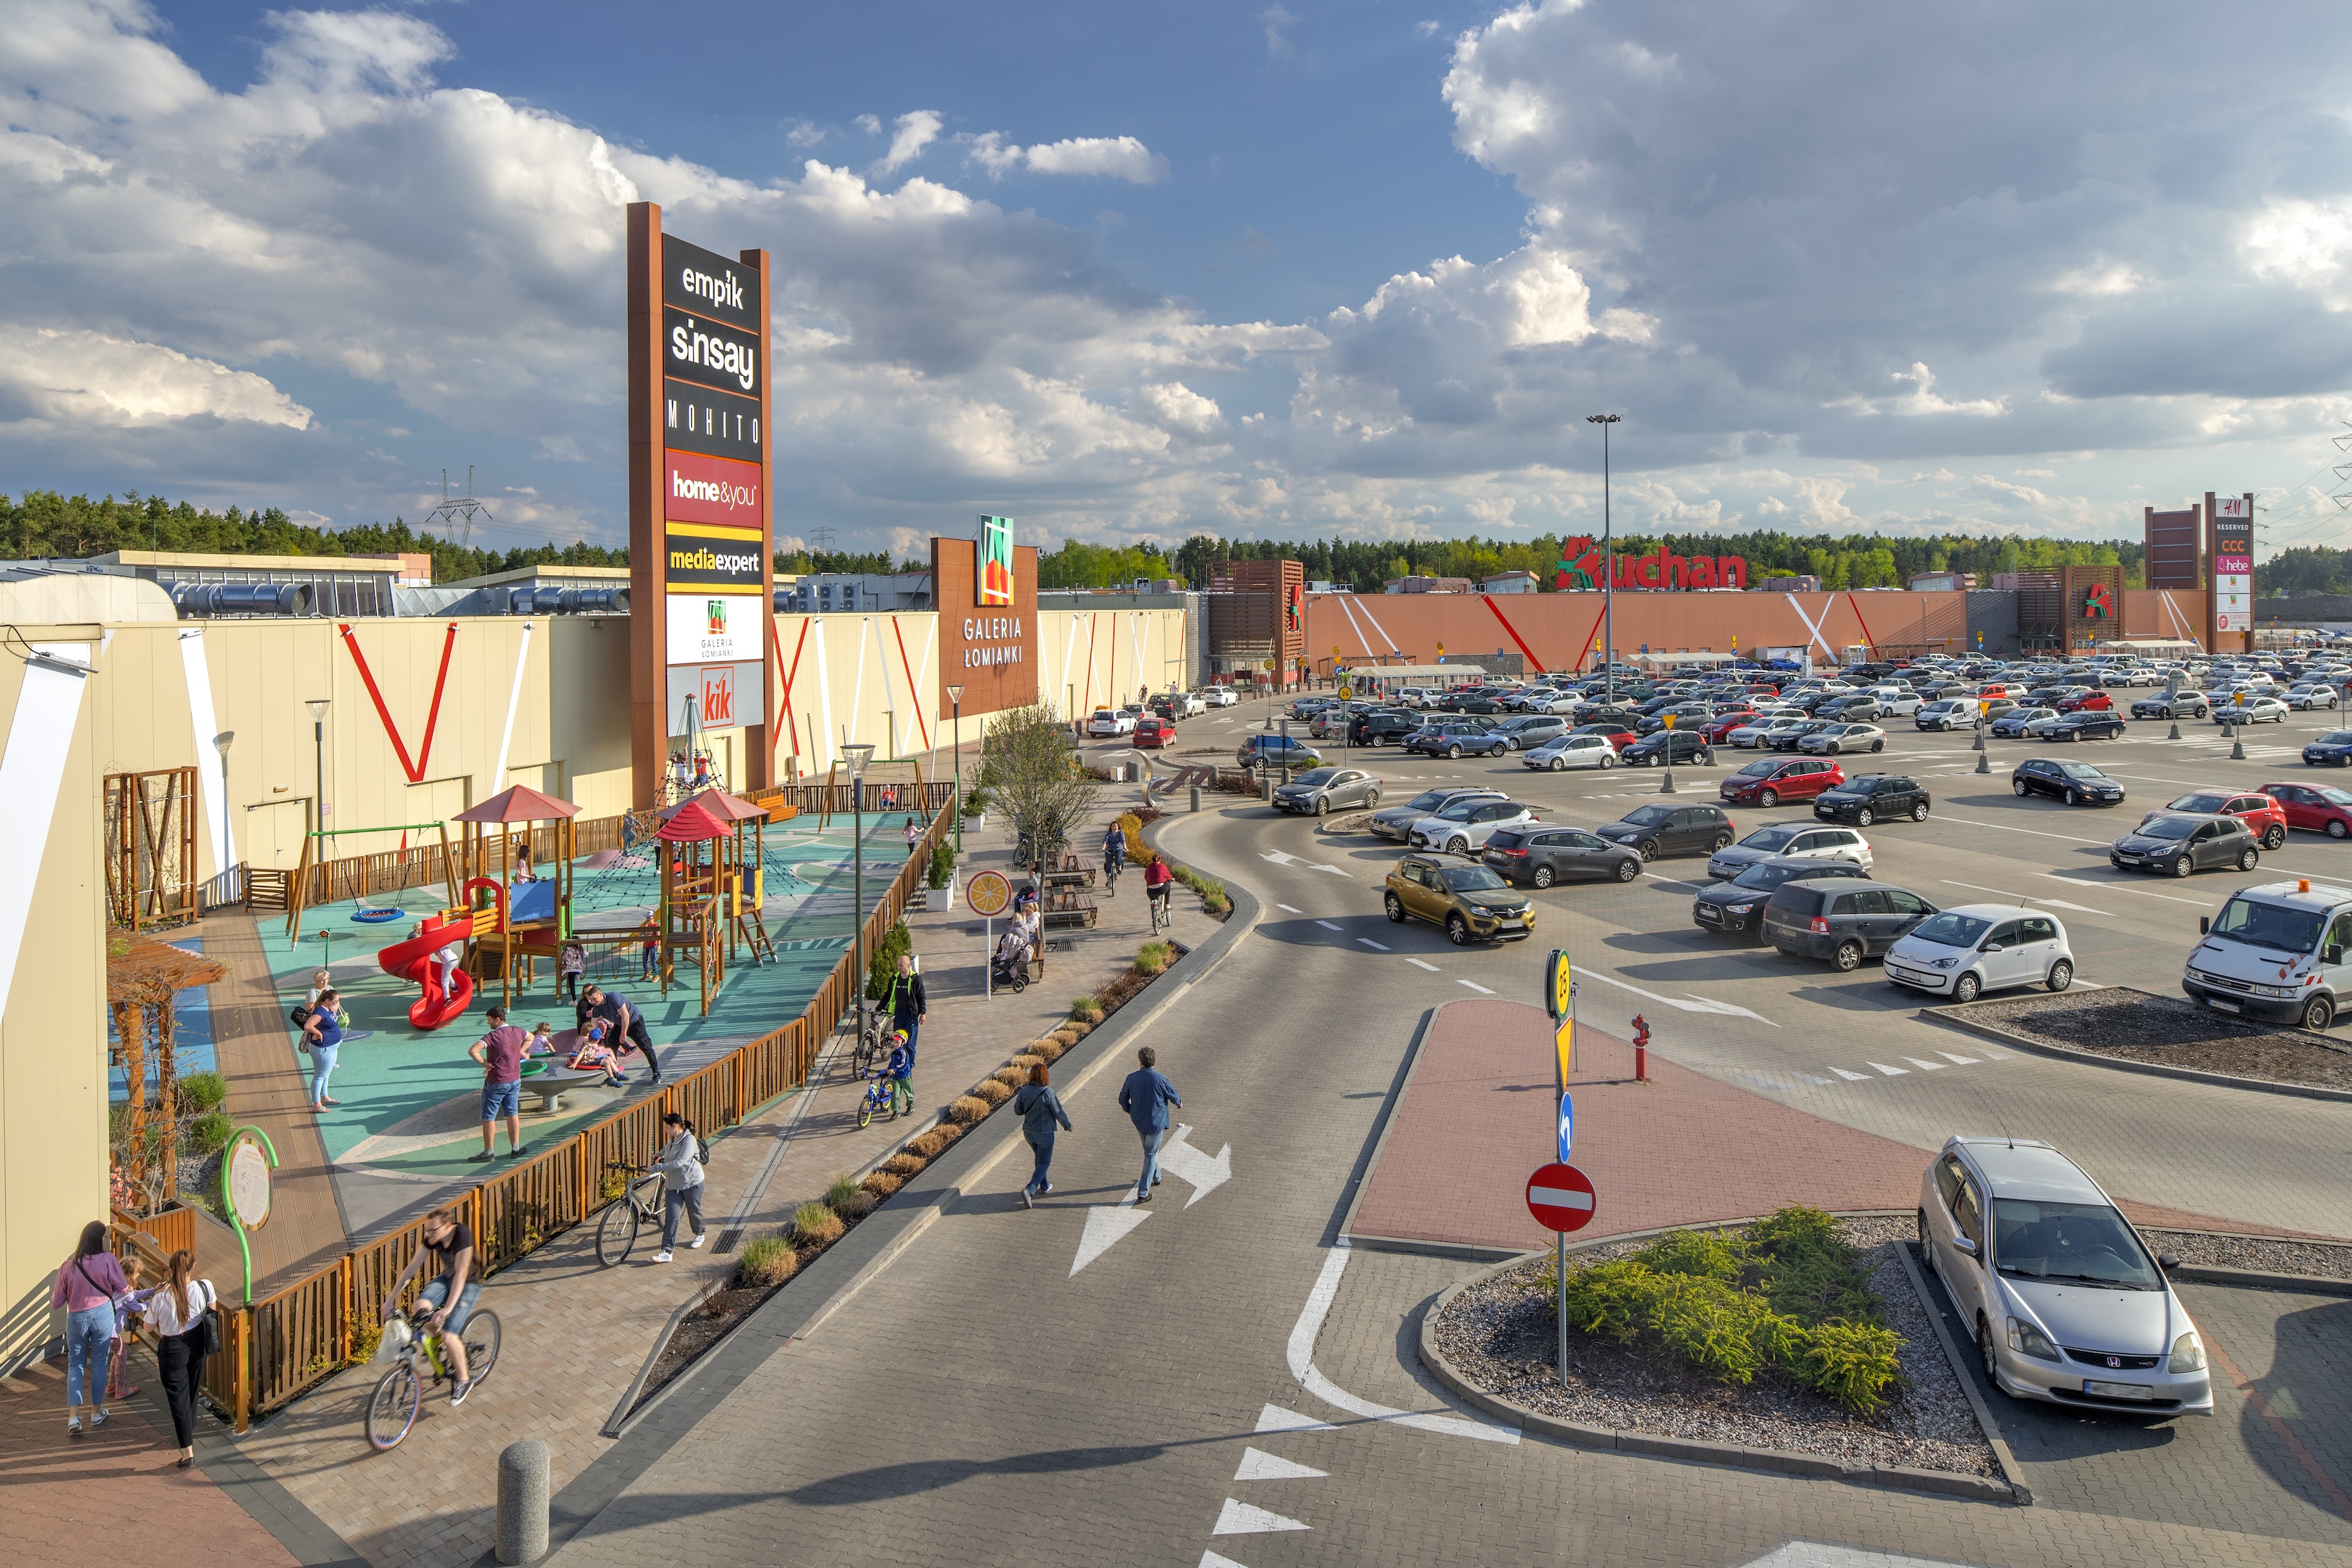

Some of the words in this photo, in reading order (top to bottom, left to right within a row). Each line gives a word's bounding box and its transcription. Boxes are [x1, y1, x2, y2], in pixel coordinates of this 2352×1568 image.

[682, 268, 744, 310] empik
[671, 318, 754, 390] sinsay
[668, 399, 759, 444] MOHITO
[672, 470, 756, 510] home&you
[2224, 499, 2241, 516] H&M
[2221, 540, 2245, 552] CCC
[670, 547, 759, 575] mediaexpert
[1556, 536, 1747, 589] Auchan
[2226, 558, 2248, 571] hebe
[963, 617, 1022, 640] GALERIA
[701, 639, 733, 648] GALERIA
[963, 645, 1022, 667] ŁOMIANKI
[704, 672, 732, 722] kik
[1559, 970, 1567, 999] 25
[1571, 988, 1576, 997] H
